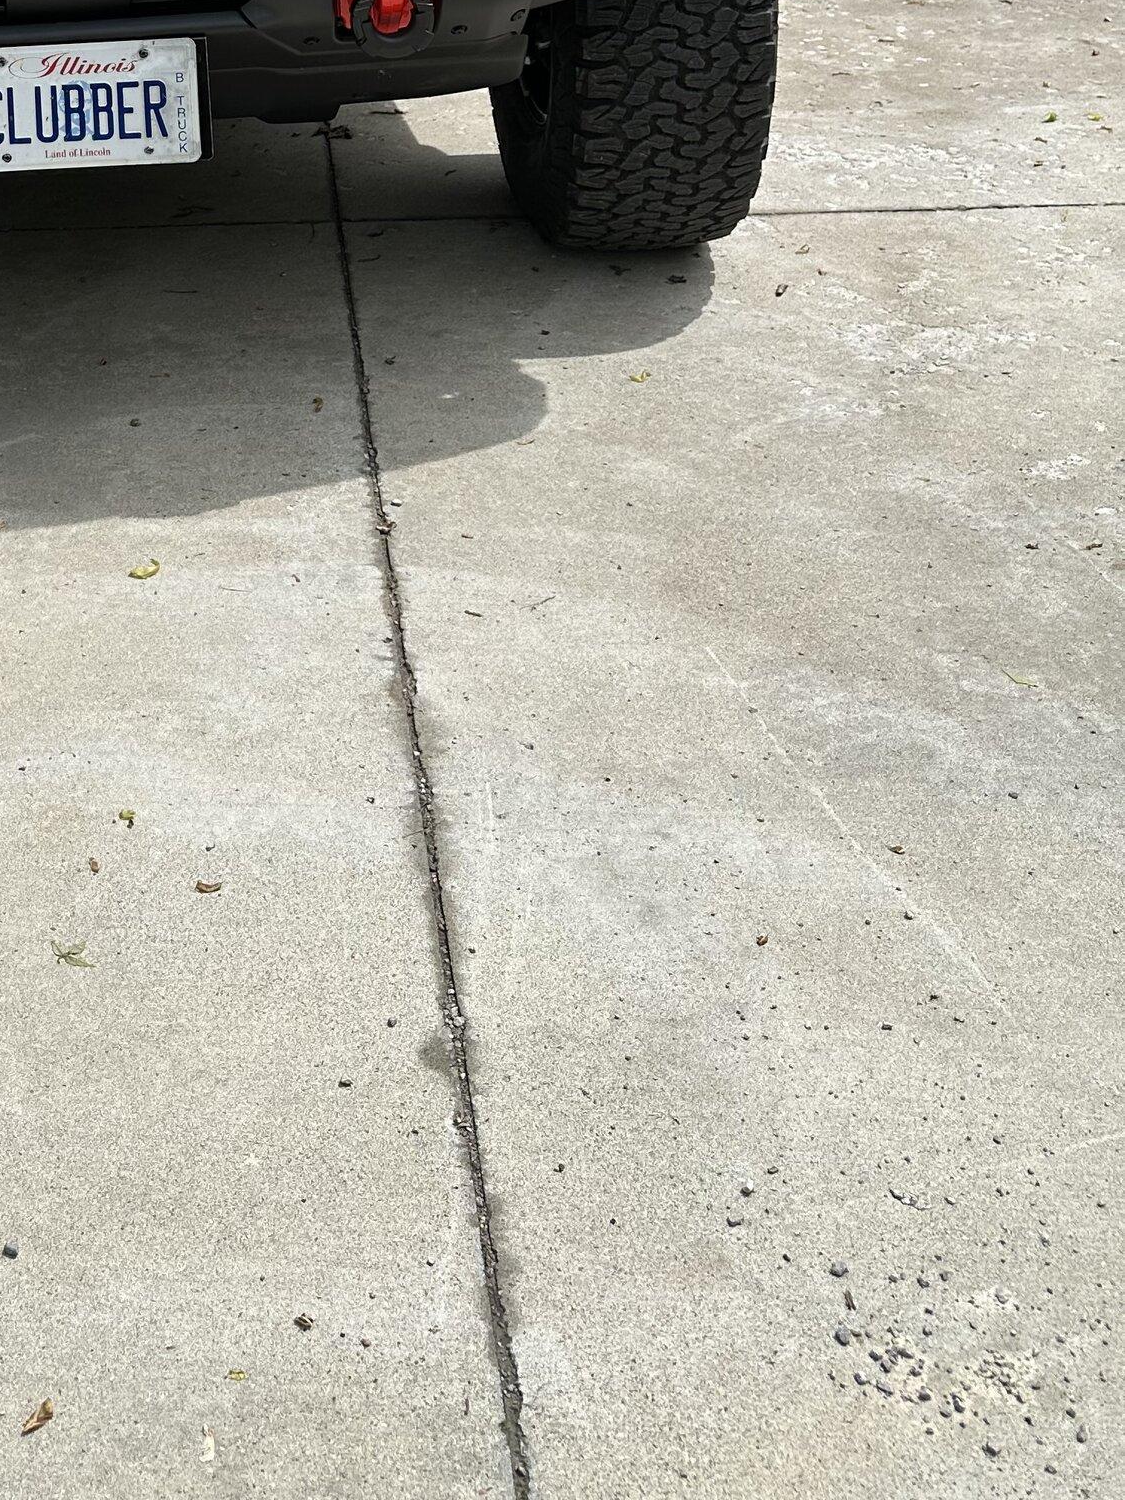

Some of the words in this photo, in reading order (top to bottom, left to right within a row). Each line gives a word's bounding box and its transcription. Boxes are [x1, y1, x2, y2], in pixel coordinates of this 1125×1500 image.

[8, 52, 141, 79] Illinois
[175, 72, 184, 83] B
[176, 95, 188, 153] TRUCK
[45, 148, 67, 159] Land
[68, 147, 78, 158] of
[79, 146, 111, 157] Lincoln
